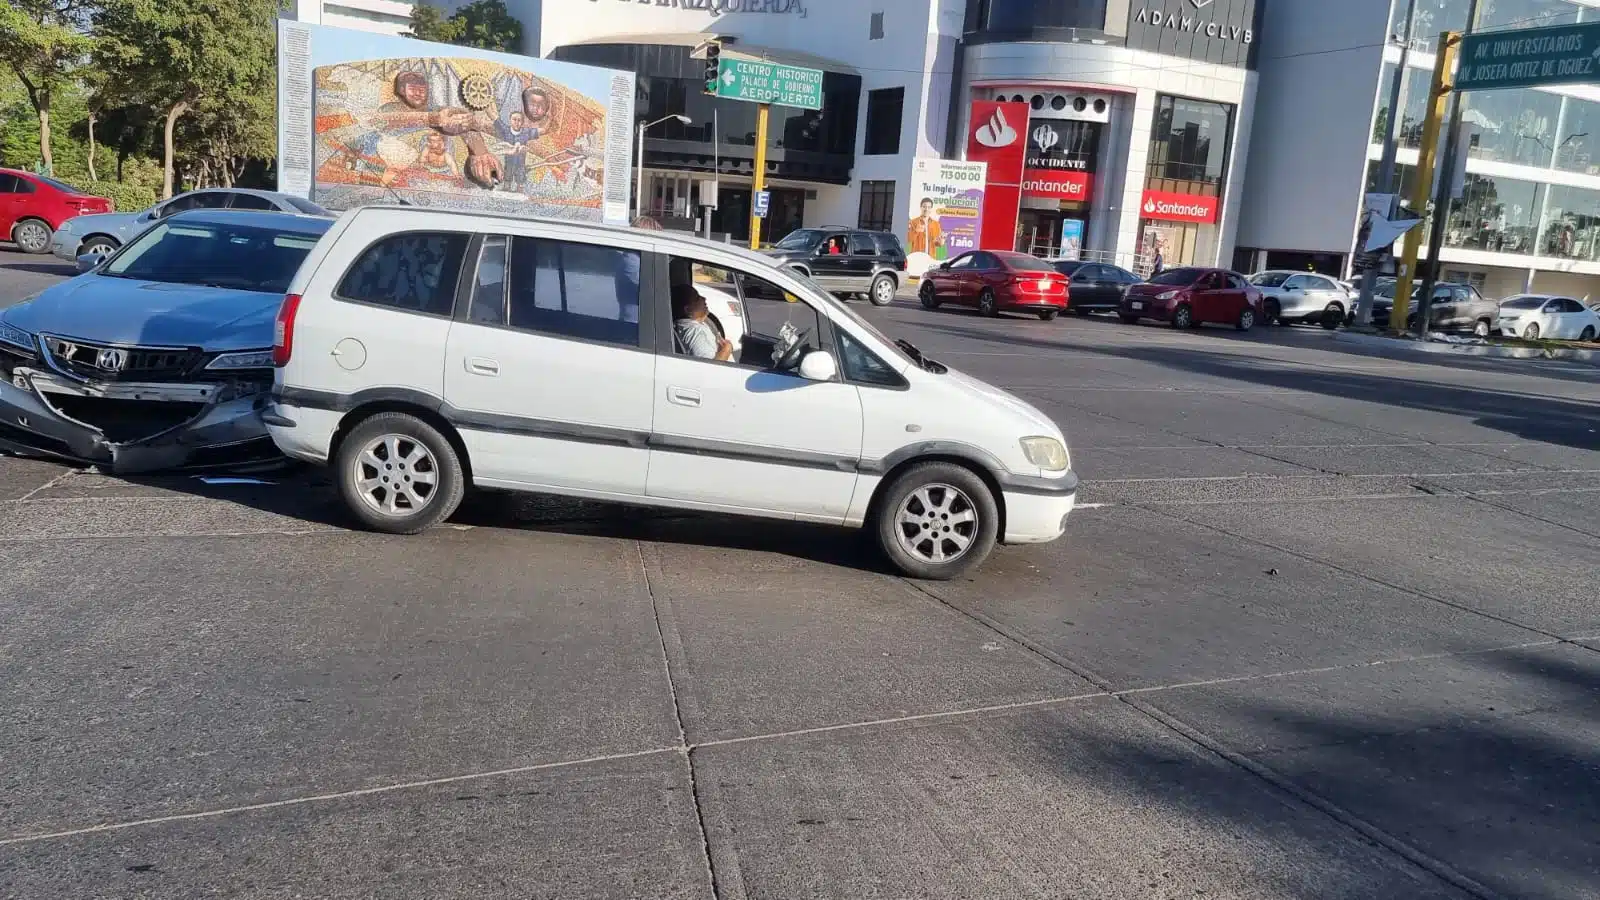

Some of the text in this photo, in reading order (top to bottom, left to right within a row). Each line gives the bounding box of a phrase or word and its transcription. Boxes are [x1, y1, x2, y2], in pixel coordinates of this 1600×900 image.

[1493, 34, 1583, 57] UNIVERSITARIOS
[736, 62, 820, 84] CENTRO HISTORICO
[1473, 63, 1507, 80] JOSEFA
[1510, 60, 1540, 78] ORTIZ
[1541, 60, 1555, 76] DE
[741, 75, 815, 94] PALACIO DE GOBIERNO
[740, 87, 816, 105] AEROPUERTO
[1028, 157, 1086, 169] OCCIDENTE
[940, 170, 954, 180] 713
[922, 182, 932, 193] Tu
[1022, 179, 1083, 194] antander
[758, 193, 768, 207] E
[1155, 200, 1209, 217] Santander
